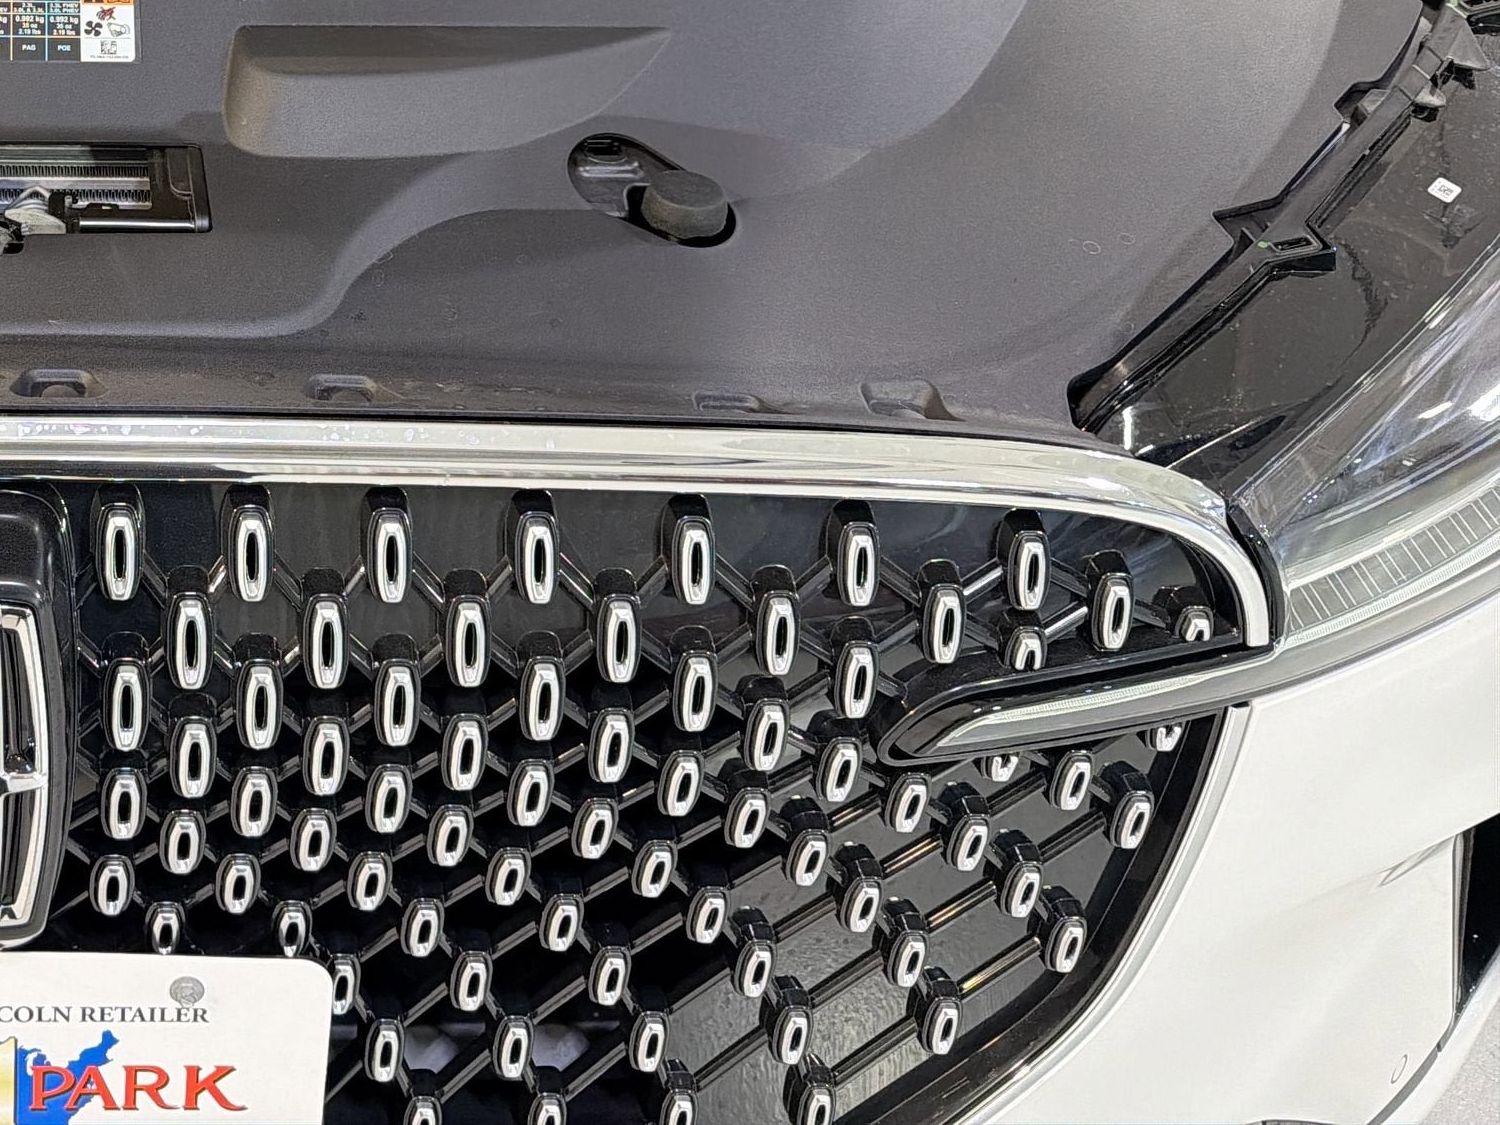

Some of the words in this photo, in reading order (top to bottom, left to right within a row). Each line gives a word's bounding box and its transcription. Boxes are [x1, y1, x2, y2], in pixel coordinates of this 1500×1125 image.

[35, 15, 44, 24] kg
[70, 16, 78, 24] kg
[78, 1005, 210, 1023] RETAILER
[29, 1065, 249, 1111] PARK
